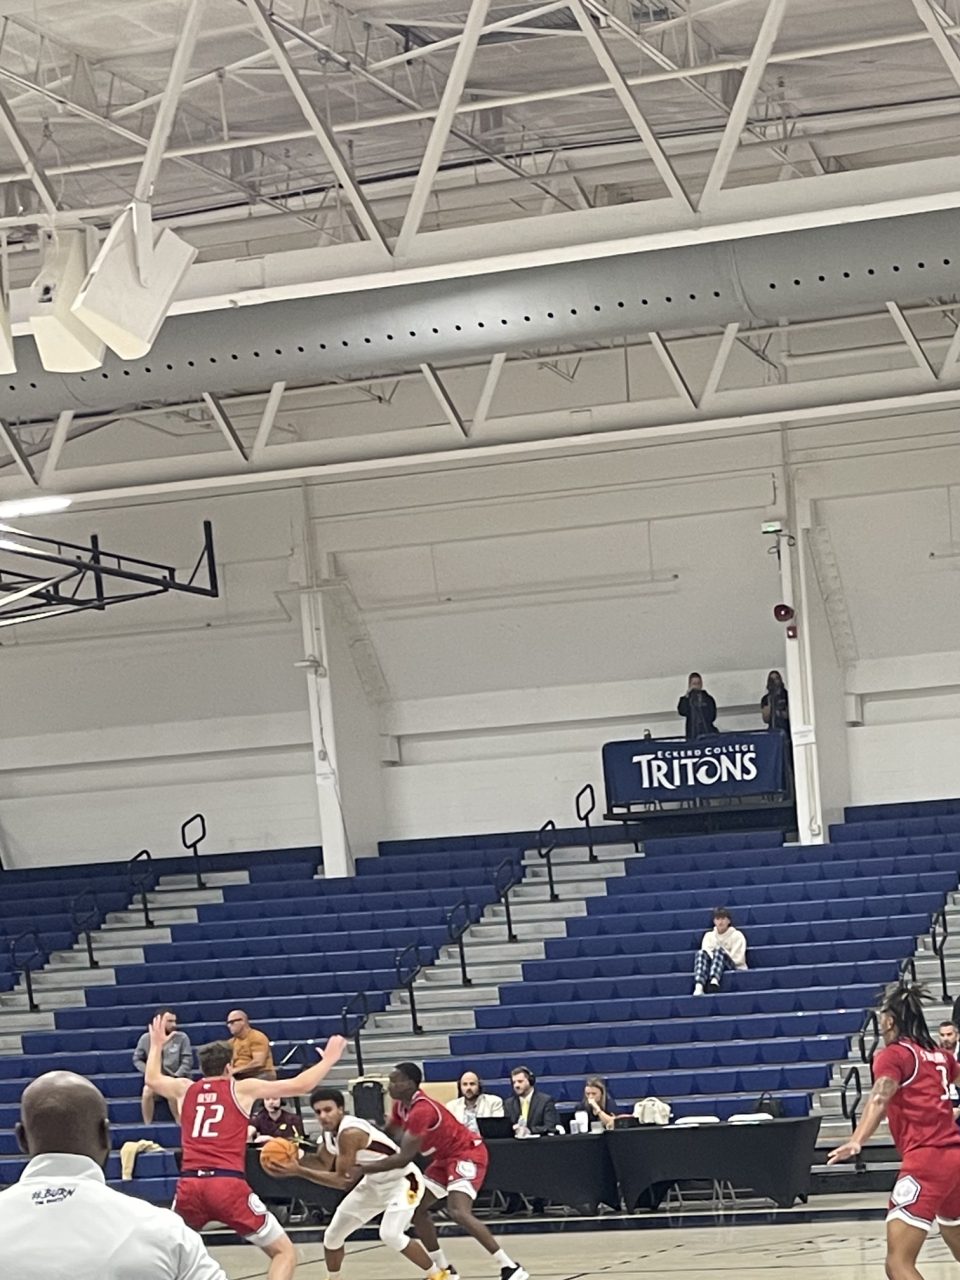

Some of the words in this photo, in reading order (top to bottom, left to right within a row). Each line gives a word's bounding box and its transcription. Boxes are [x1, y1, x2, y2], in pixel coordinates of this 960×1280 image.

[704, 744, 755, 756] COLLEGE
[632, 752, 758, 790] TRITONS
[191, 1104, 225, 1138] 12
